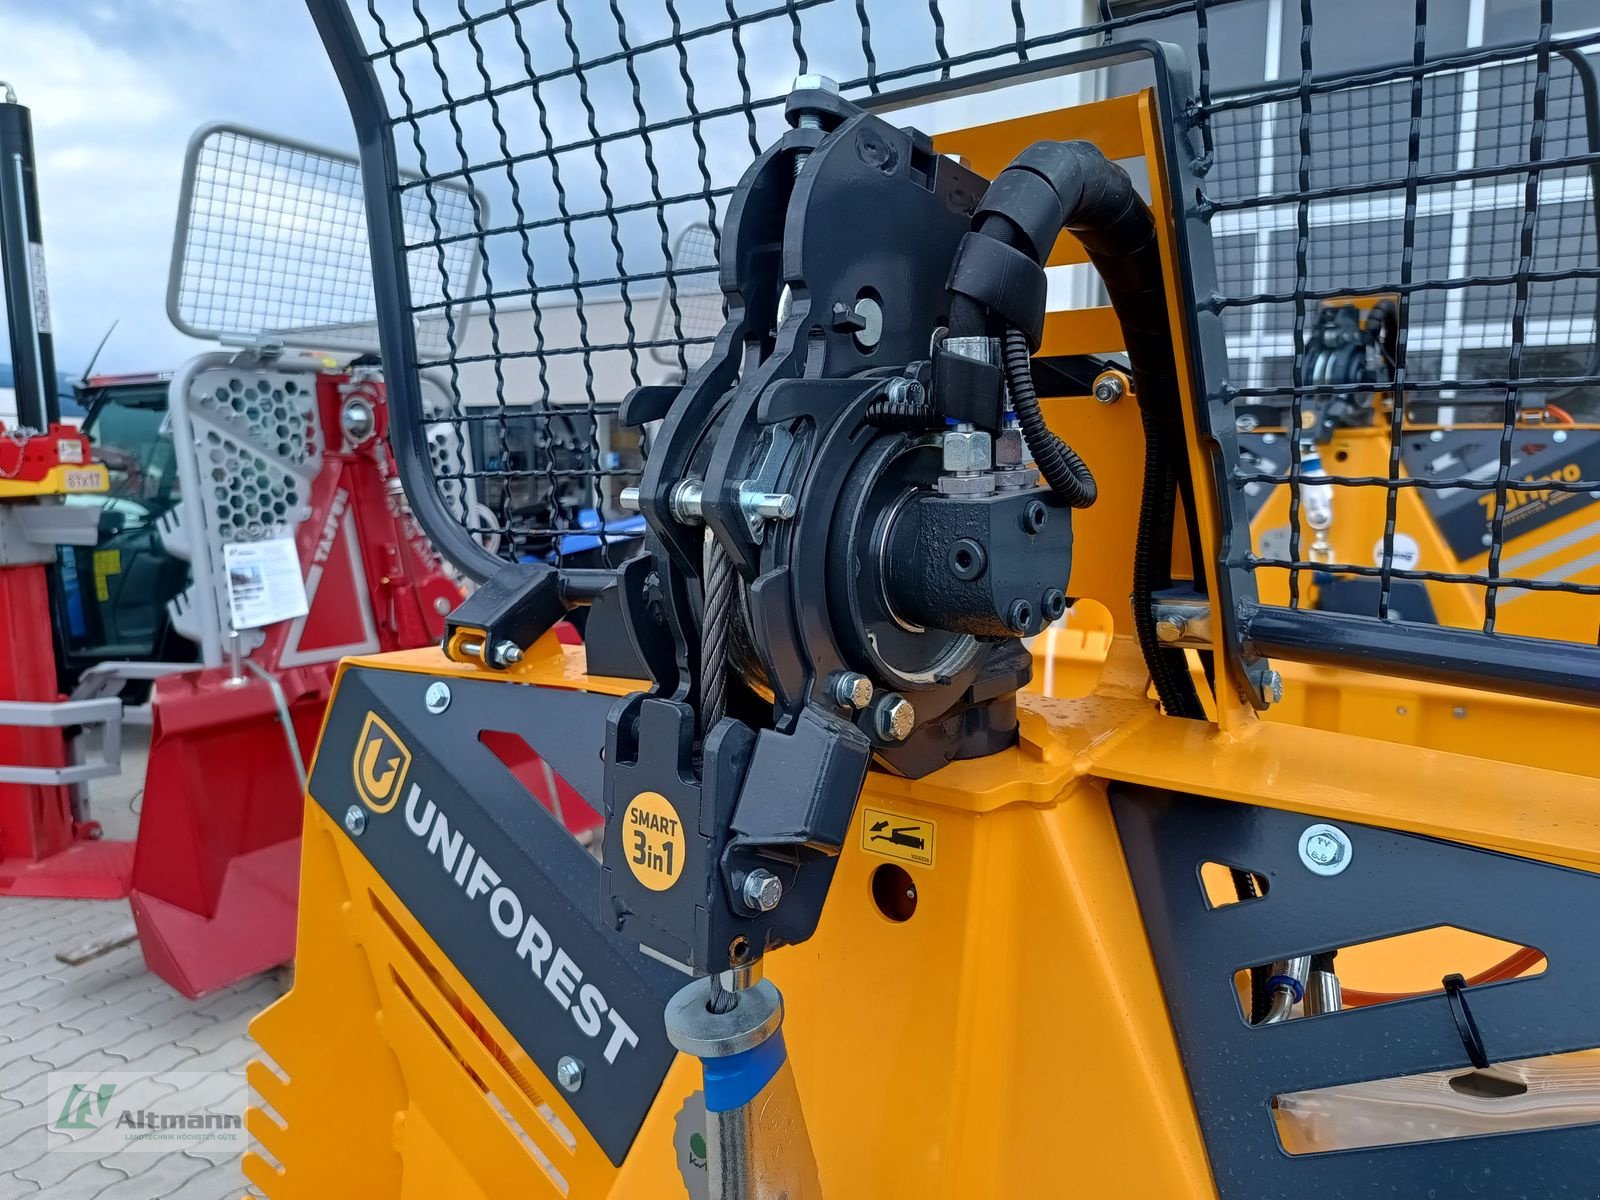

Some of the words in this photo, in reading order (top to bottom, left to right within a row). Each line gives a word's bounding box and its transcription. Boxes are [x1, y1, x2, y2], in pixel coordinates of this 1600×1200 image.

[630, 807, 678, 837] SMART
[633, 829, 673, 876] 3in1
[405, 782, 639, 1065] UNIFOREST
